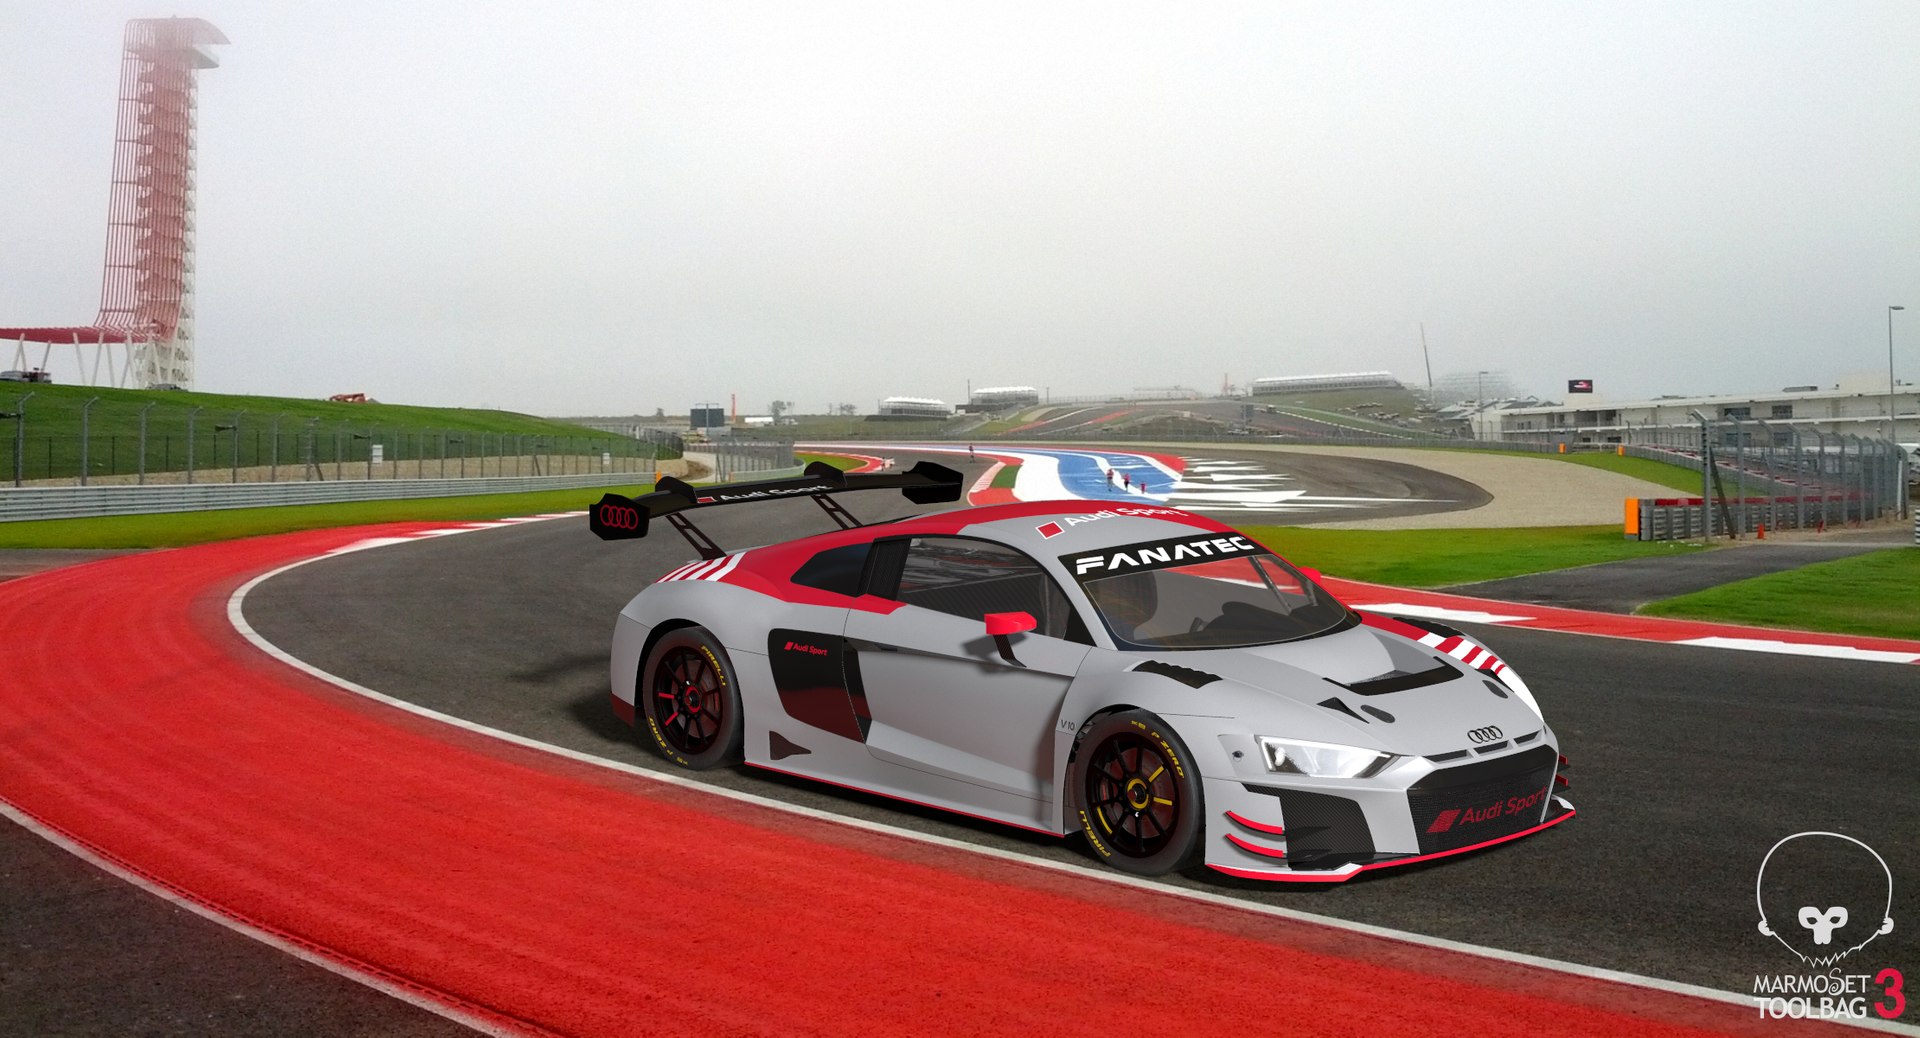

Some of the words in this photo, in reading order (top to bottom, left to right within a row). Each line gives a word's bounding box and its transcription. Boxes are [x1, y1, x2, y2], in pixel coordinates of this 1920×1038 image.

[720, 491, 770, 501] Audi
[769, 485, 833, 495] Sport
[1064, 509, 1120, 527] Audi
[1116, 507, 1189, 518] Sport
[1076, 536, 1255, 575] FANATEC
[701, 645, 726, 687] PIRELLI
[793, 642, 809, 652] Audi
[809, 645, 828, 656] Sport
[1160, 740, 1185, 779] ZERO
[1459, 800, 1504, 825] Audi
[1505, 785, 1547, 816] Sport
[1079, 810, 1112, 858] PIRELLI
